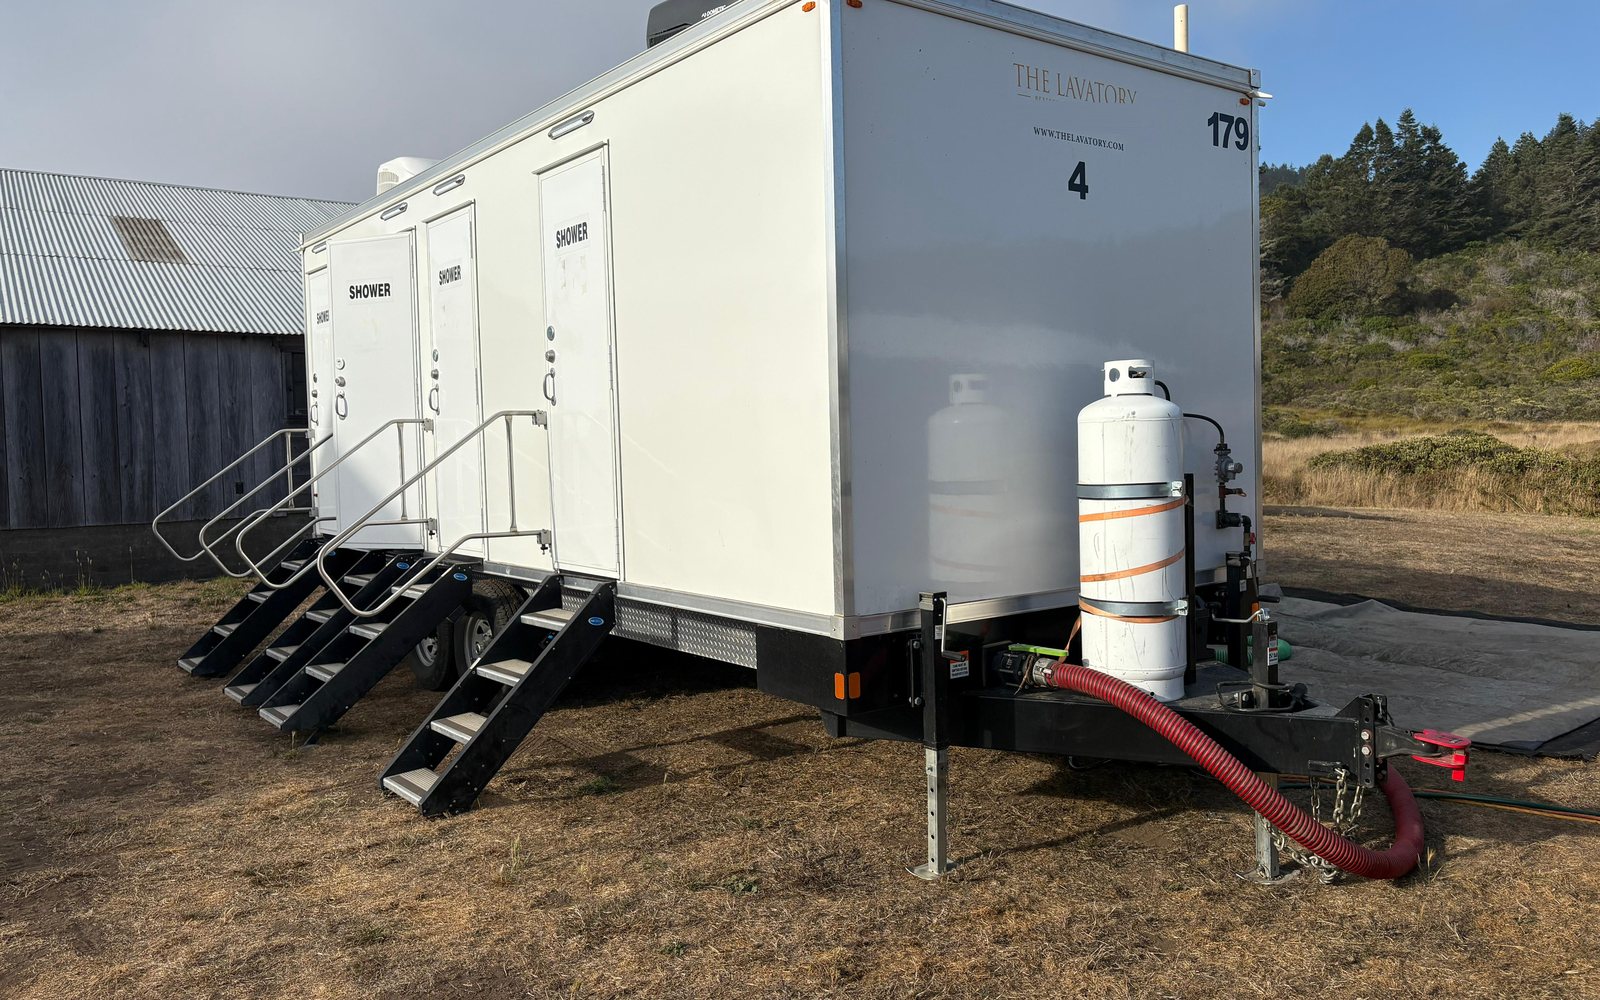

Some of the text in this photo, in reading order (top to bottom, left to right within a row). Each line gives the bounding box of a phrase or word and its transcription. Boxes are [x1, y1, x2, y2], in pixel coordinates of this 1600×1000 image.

[1013, 62, 1137, 104] THE LAVATORY
[1033, 126, 1125, 152] WWW.THELAVATORY.COM
[1207, 111, 1250, 151] 179
[1067, 160, 1089, 200] 4
[556, 221, 589, 249] SHOWER
[438, 264, 462, 286] SHOWER
[349, 282, 391, 300] SHOWER
